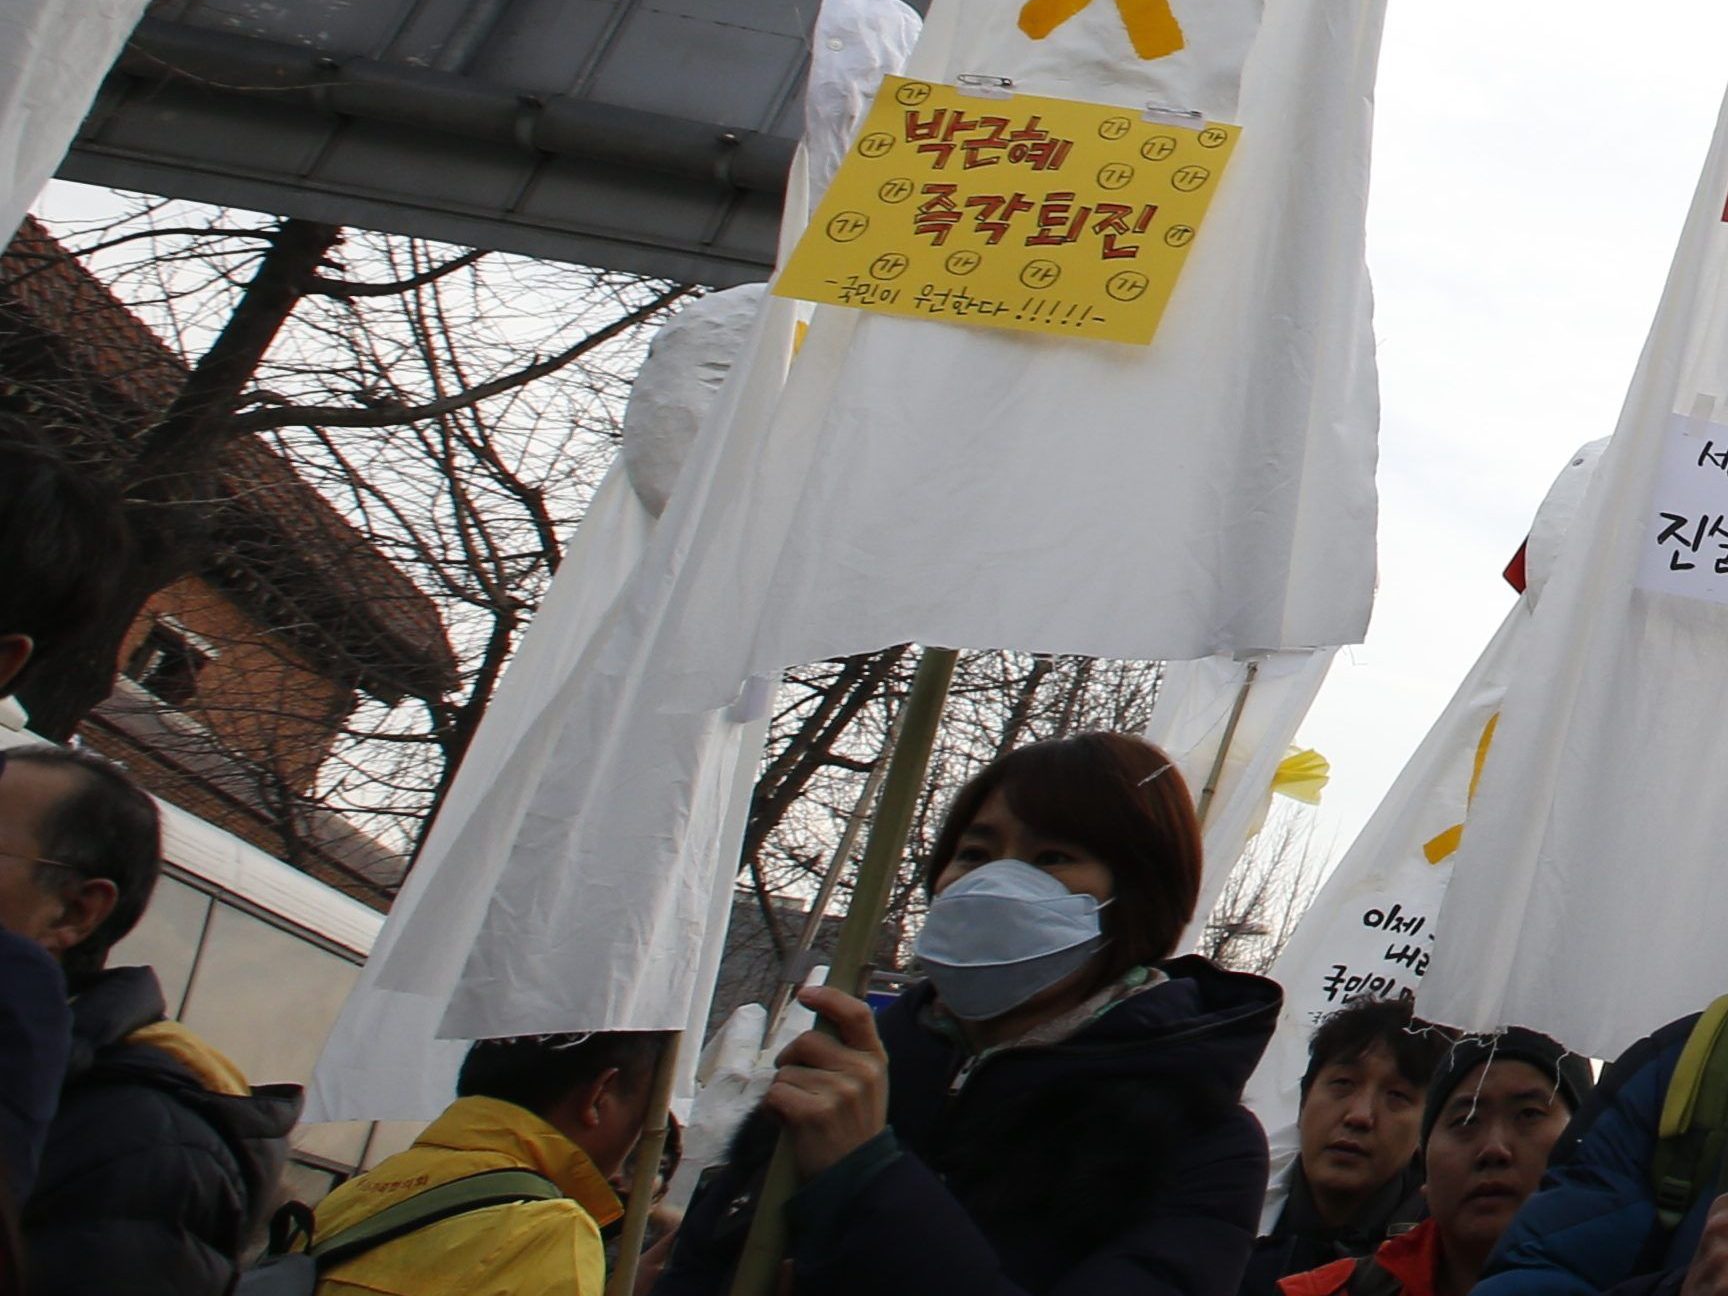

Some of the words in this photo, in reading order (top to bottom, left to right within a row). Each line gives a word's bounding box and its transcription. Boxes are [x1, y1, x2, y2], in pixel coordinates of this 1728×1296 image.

[898, 84, 929, 103] 가
[1100, 118, 1129, 138] 가
[1200, 130, 1225, 146] 가
[861, 134, 893, 156] 가
[905, 109, 1074, 171] 박근혜
[1143, 137, 1173, 159] 가
[1100, 164, 1131, 188] 가
[1174, 167, 1207, 190] 가
[881, 179, 912, 201] 가
[829, 213, 866, 240] 가
[913, 183, 1158, 260] 즉각퇴진
[873, 254, 906, 278] 가
[948, 252, 978, 273] 가
[1023, 261, 1058, 287] 가
[1109, 272, 1146, 299] 가
[1363, 904, 1425, 936] 이제
